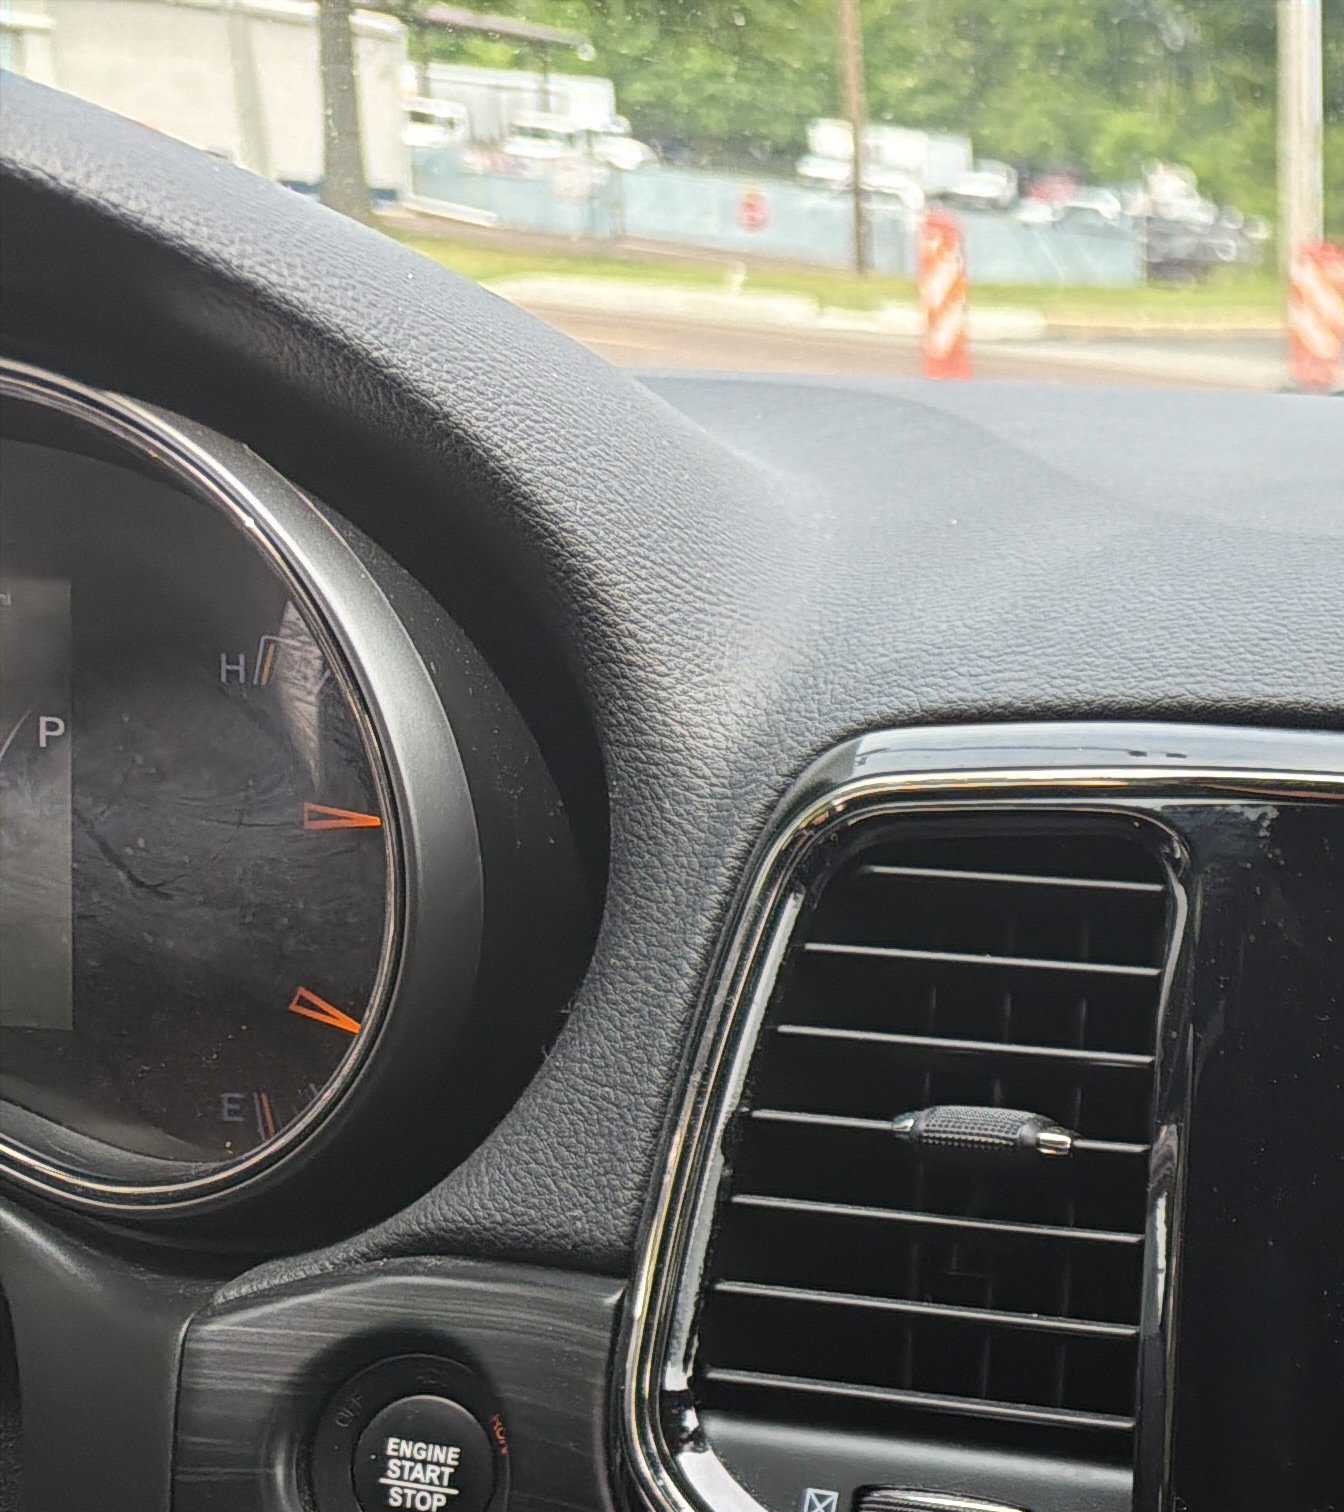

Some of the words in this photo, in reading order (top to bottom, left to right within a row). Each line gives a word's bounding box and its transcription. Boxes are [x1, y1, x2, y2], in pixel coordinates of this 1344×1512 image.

[220, 653, 246, 684] H
[39, 716, 65, 748] P
[220, 1092, 246, 1122] E
[386, 1437, 461, 1466] ENGINE
[386, 1459, 455, 1487] START
[388, 1486, 447, 1512] STOP
